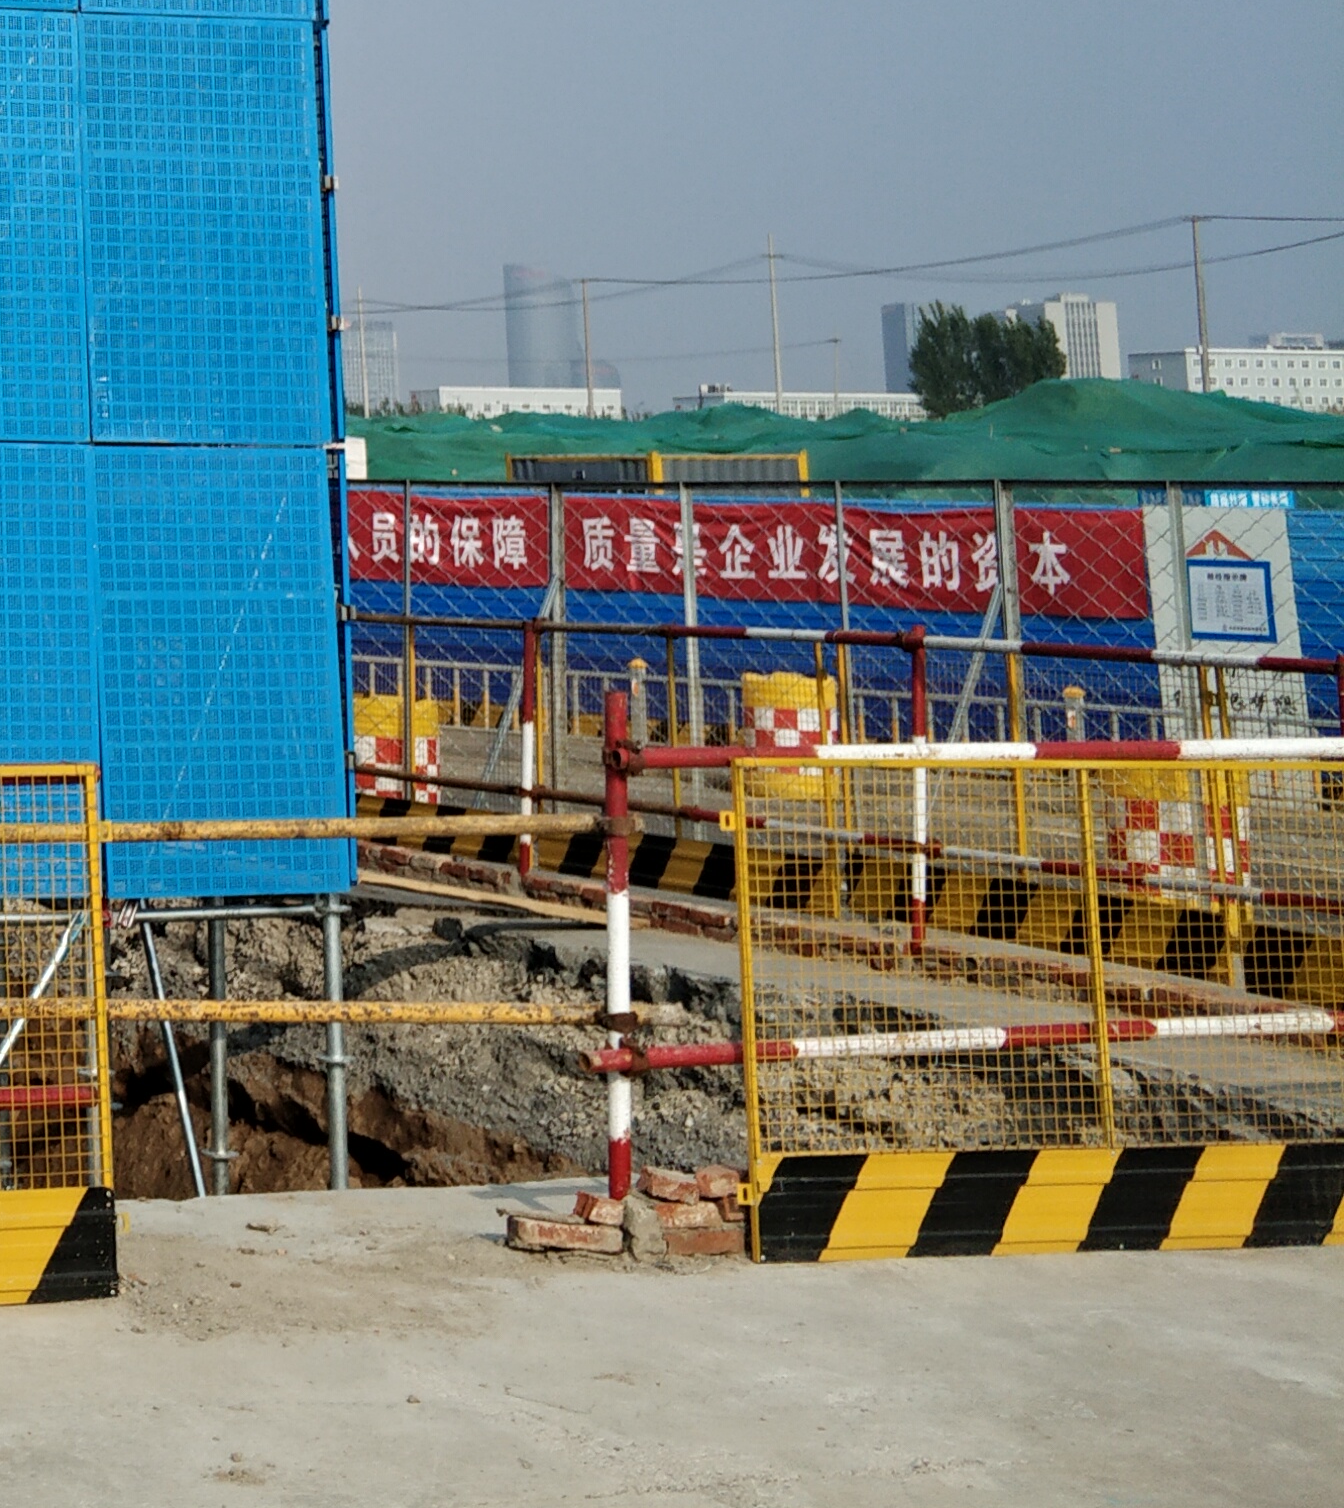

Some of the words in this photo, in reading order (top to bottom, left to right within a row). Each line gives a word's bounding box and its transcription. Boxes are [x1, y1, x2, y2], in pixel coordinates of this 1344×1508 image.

[348, 511, 528, 570] 员的保障
[582, 515, 1071, 595] 质量是企业发展的资本
